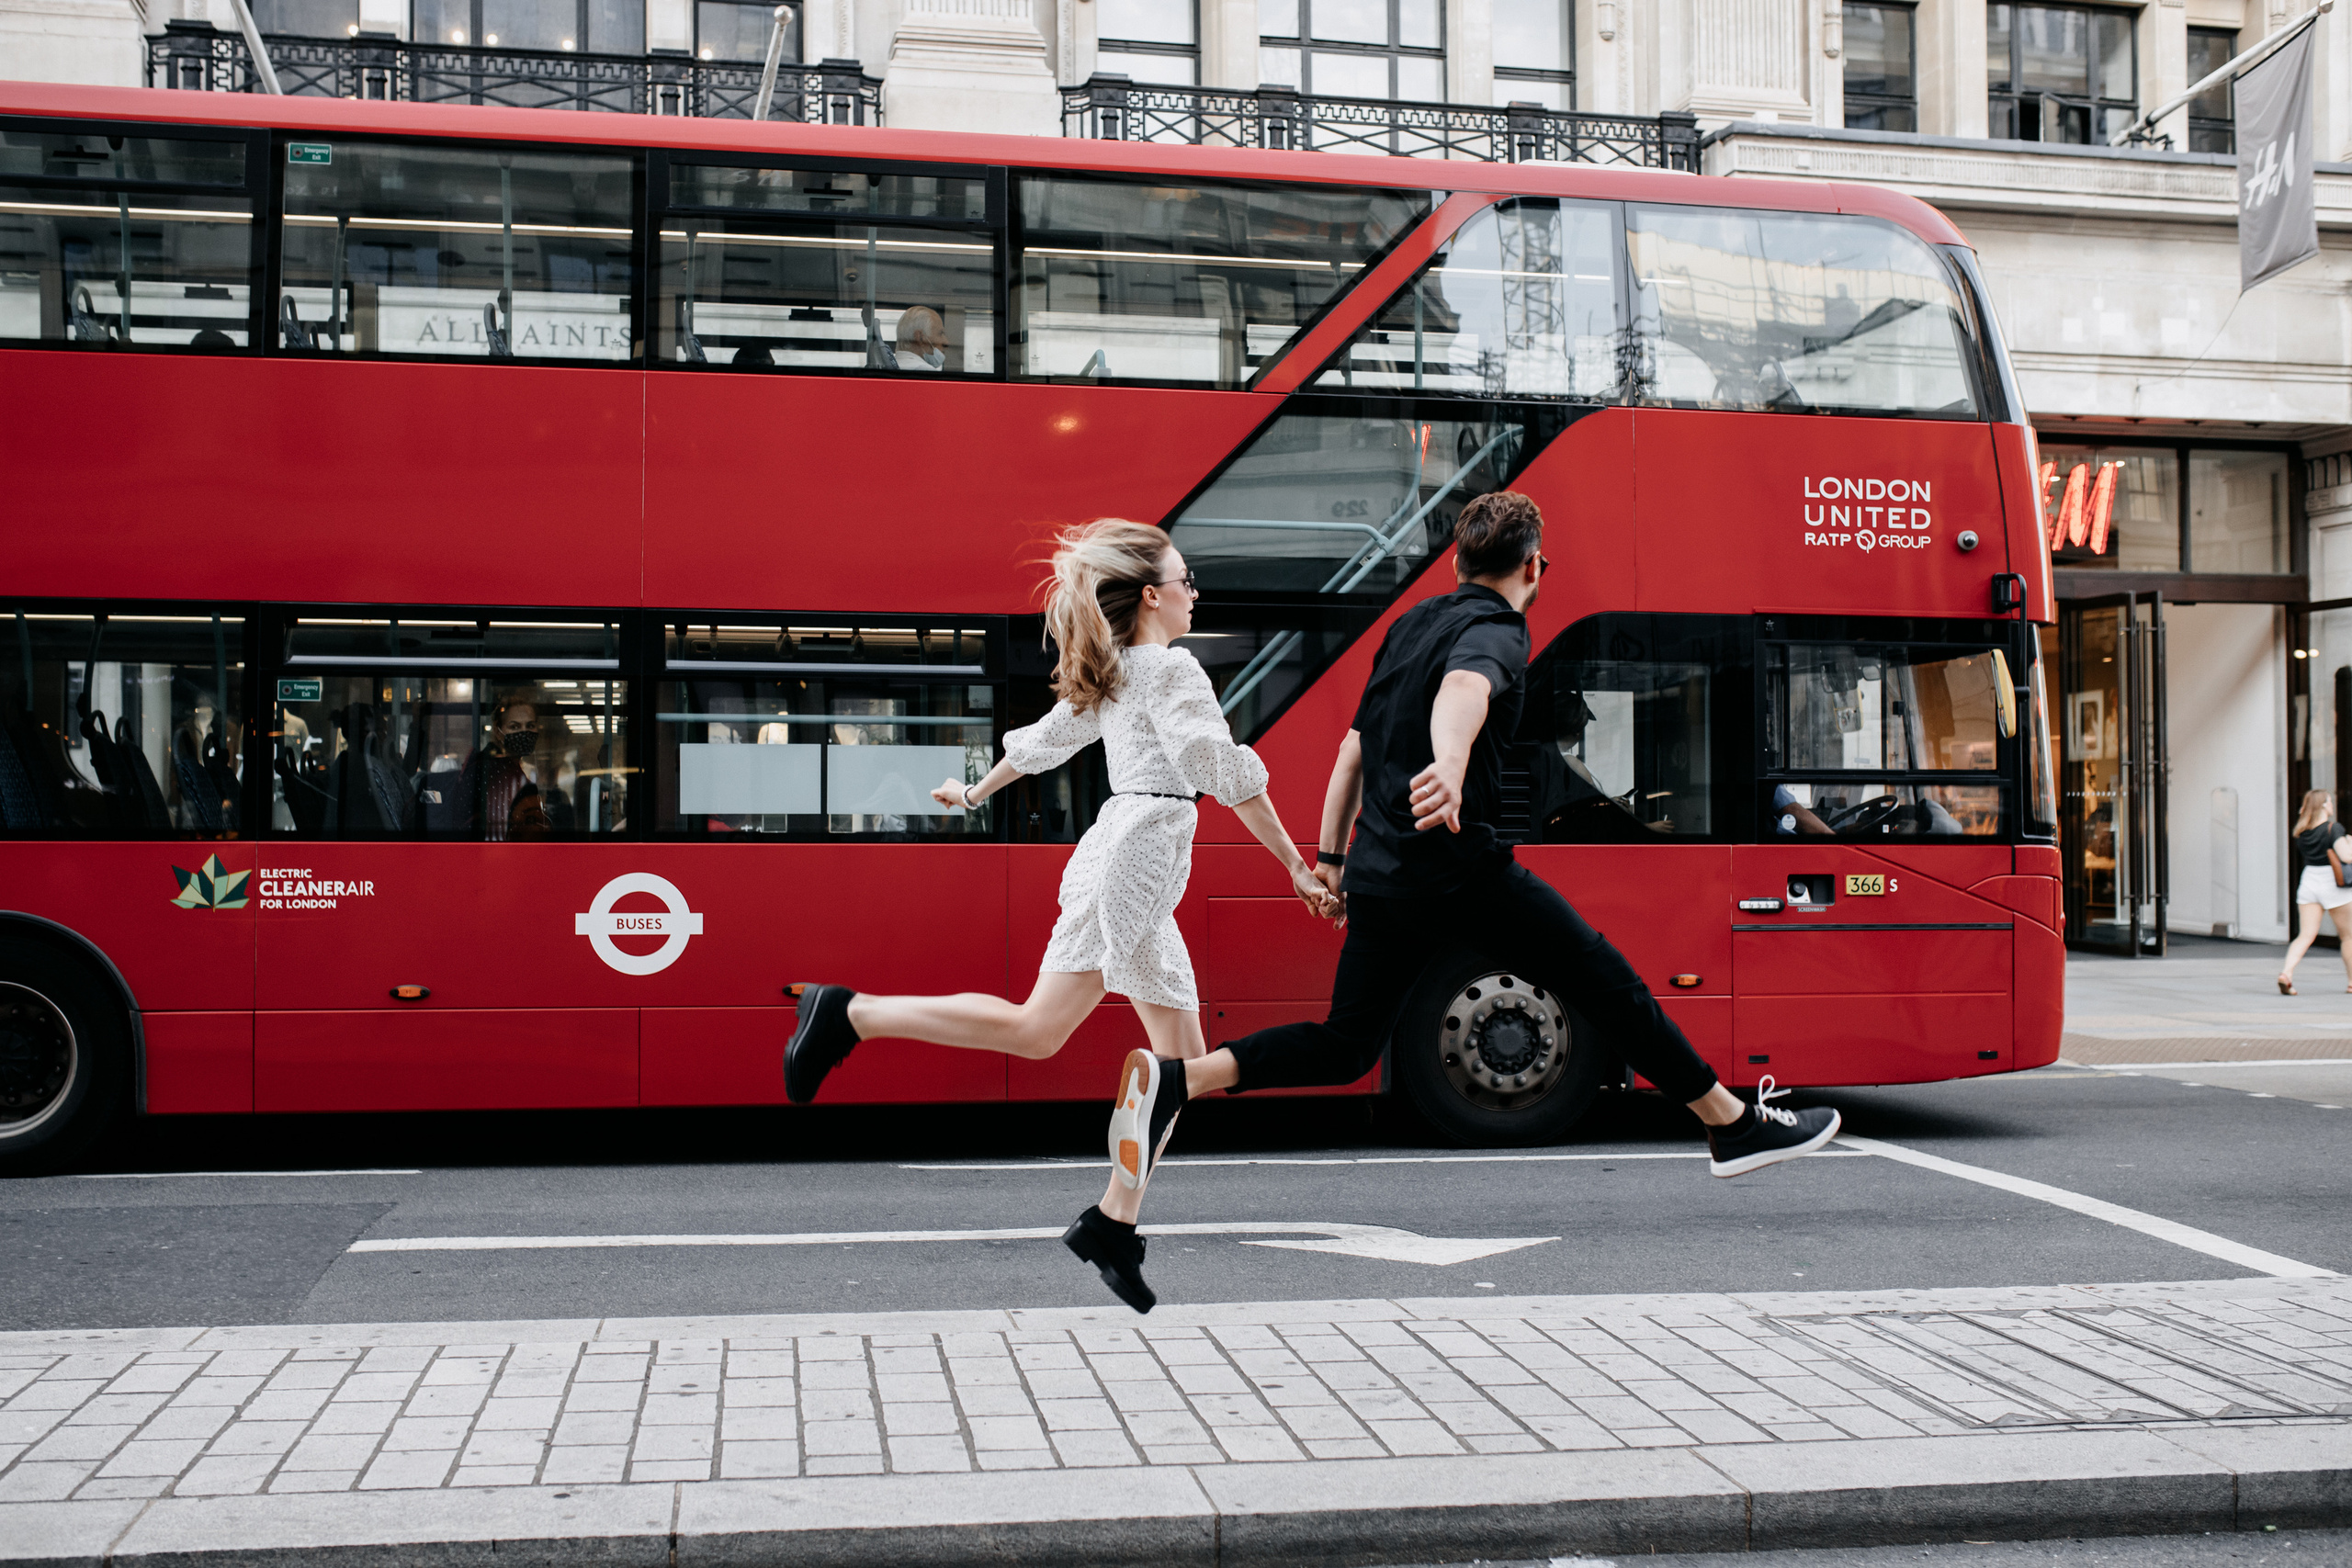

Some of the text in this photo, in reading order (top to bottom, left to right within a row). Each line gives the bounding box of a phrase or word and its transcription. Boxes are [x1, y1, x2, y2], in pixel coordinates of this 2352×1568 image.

[419, 321, 631, 348] ALLAINTS
[1804, 476, 1931, 502] LONDON
[1804, 504, 1931, 530] UNITED
[1804, 532, 1931, 549] RATP GROUP
[260, 868, 312, 878] ELECTRIC
[1850, 877, 1898, 893] 366 S
[260, 899, 336, 909] FOR LONDON
[616, 918, 662, 930] BUSES
